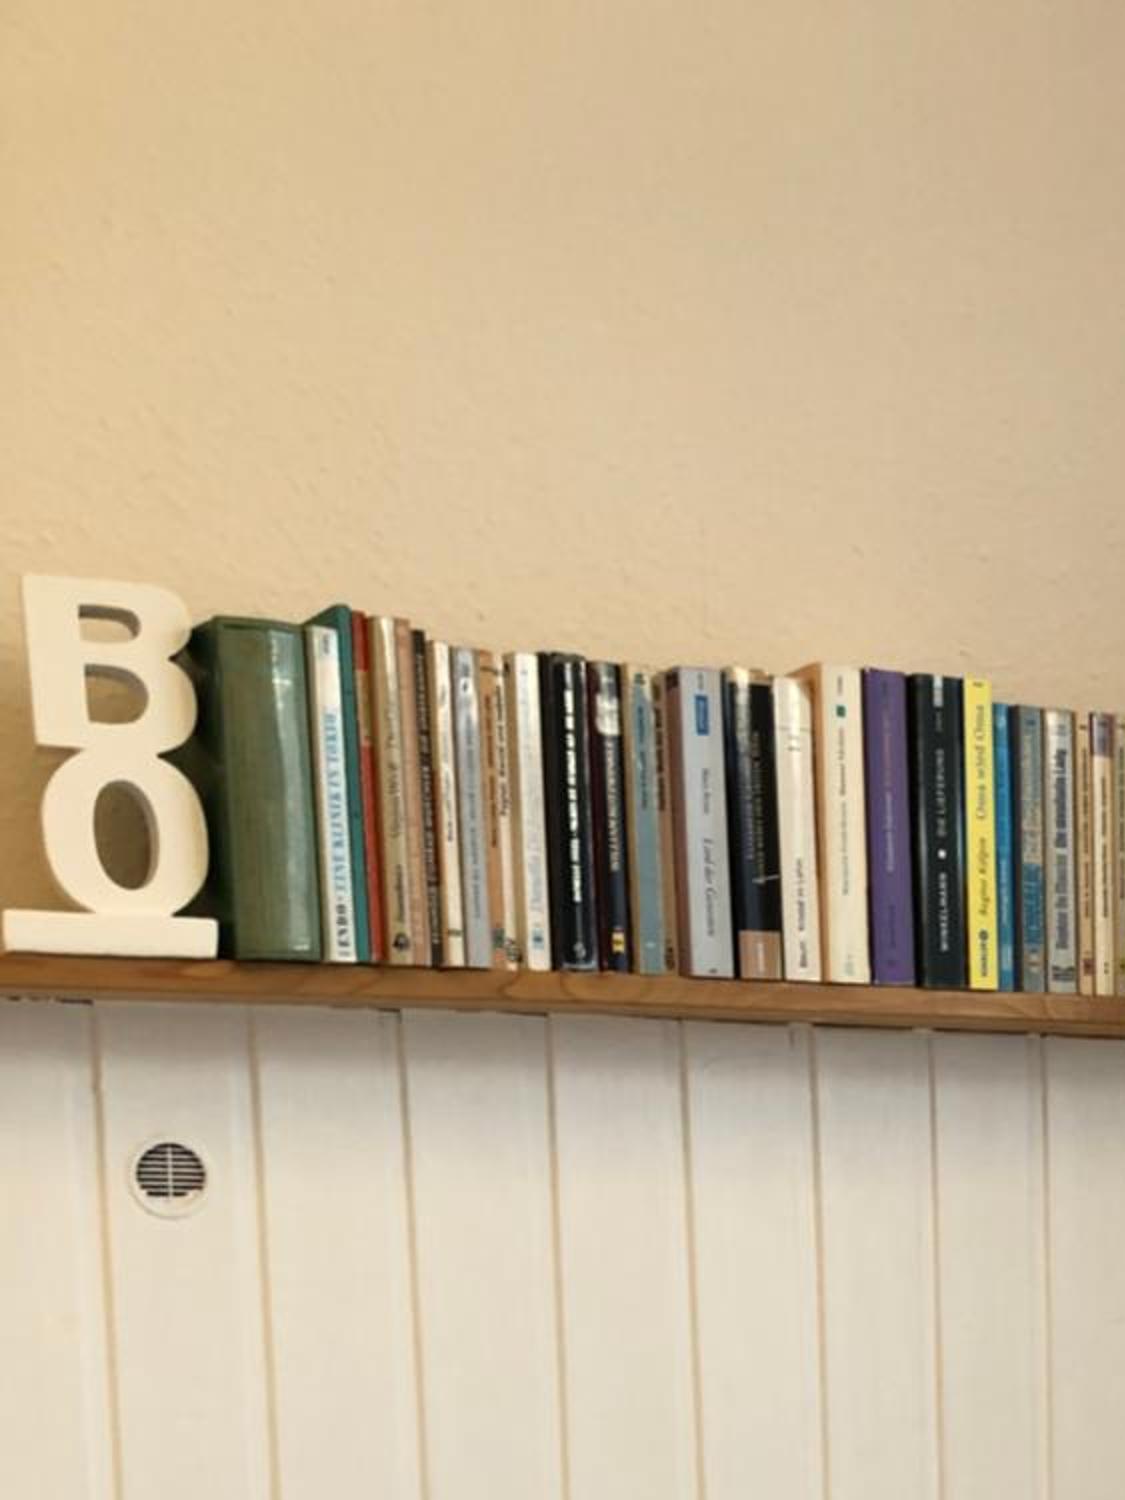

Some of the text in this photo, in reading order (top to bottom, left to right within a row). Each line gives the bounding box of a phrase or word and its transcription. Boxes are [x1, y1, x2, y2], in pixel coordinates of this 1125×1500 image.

[934, 748, 946, 815] LIEFERUNG
[334, 903, 350, 948] ENDO
[938, 872, 950, 952] WINKELMANN
